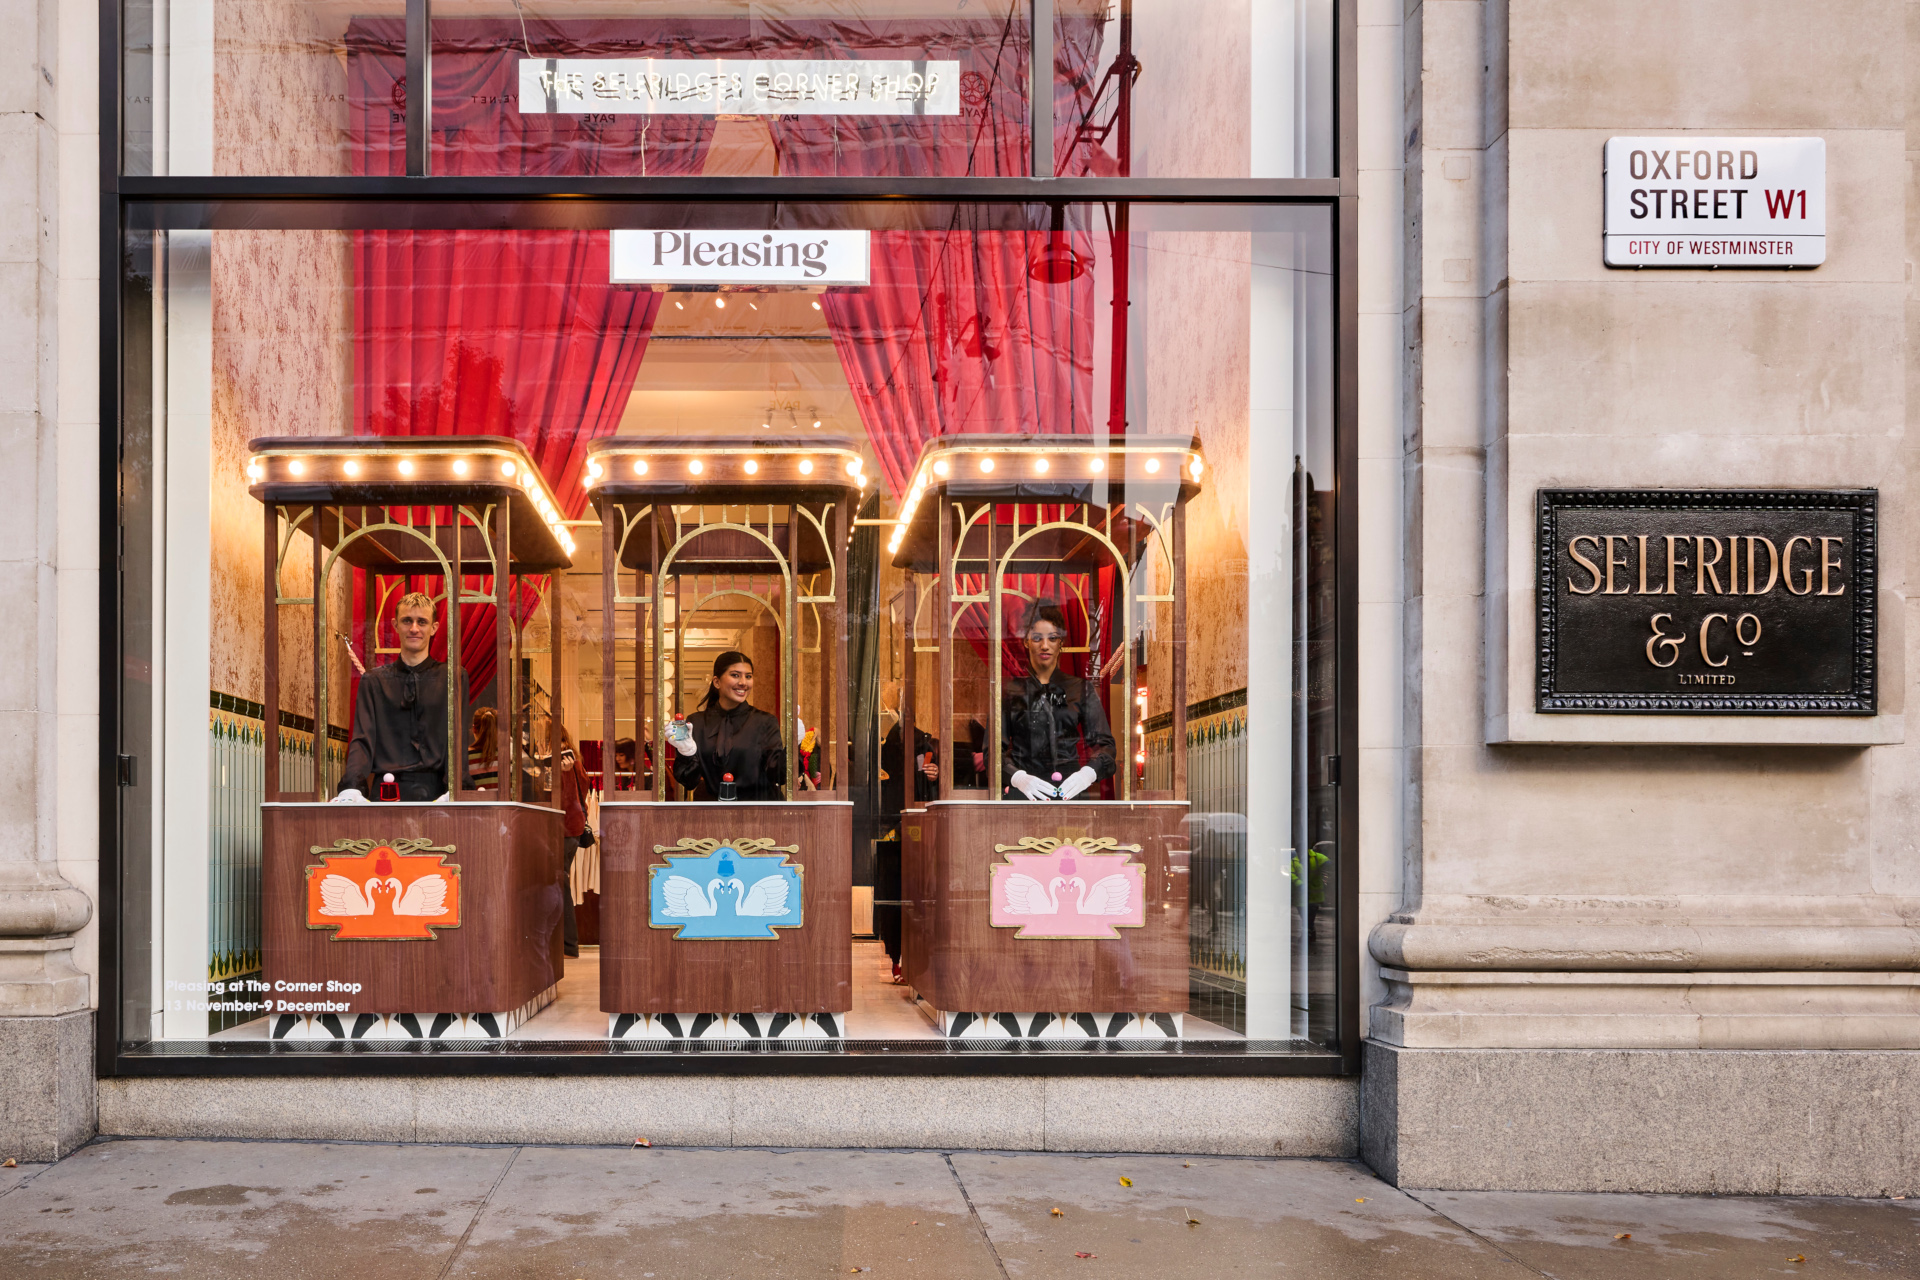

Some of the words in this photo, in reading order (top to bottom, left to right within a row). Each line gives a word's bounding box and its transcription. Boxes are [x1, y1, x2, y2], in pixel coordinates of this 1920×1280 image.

[540, 71, 583, 101] THE
[592, 72, 743, 101] SELFRIDGES
[753, 72, 860, 101] CORNER
[870, 72, 940, 101] SHOP
[1629, 149, 1758, 181] OXFORD
[1629, 188, 1749, 220] STREET
[1764, 188, 1807, 220] W1
[652, 230, 829, 278] Pleasing
[1628, 240, 1661, 255] CITY
[1666, 240, 1684, 255] OF
[1689, 240, 1794, 255] WESTMINSTER
[1567, 535, 1846, 596] SELFRIDGE
[1645, 612, 1687, 668] &
[1678, 673, 1736, 685] LIMITED
[165, 980, 225, 995] Pleasing
[229, 980, 245, 992] at
[246, 980, 271, 992] The
[275, 980, 323, 992] Corner
[326, 980, 362, 995] Shop
[166, 1000, 182, 1012] 13
[277, 1000, 351, 1012] December
